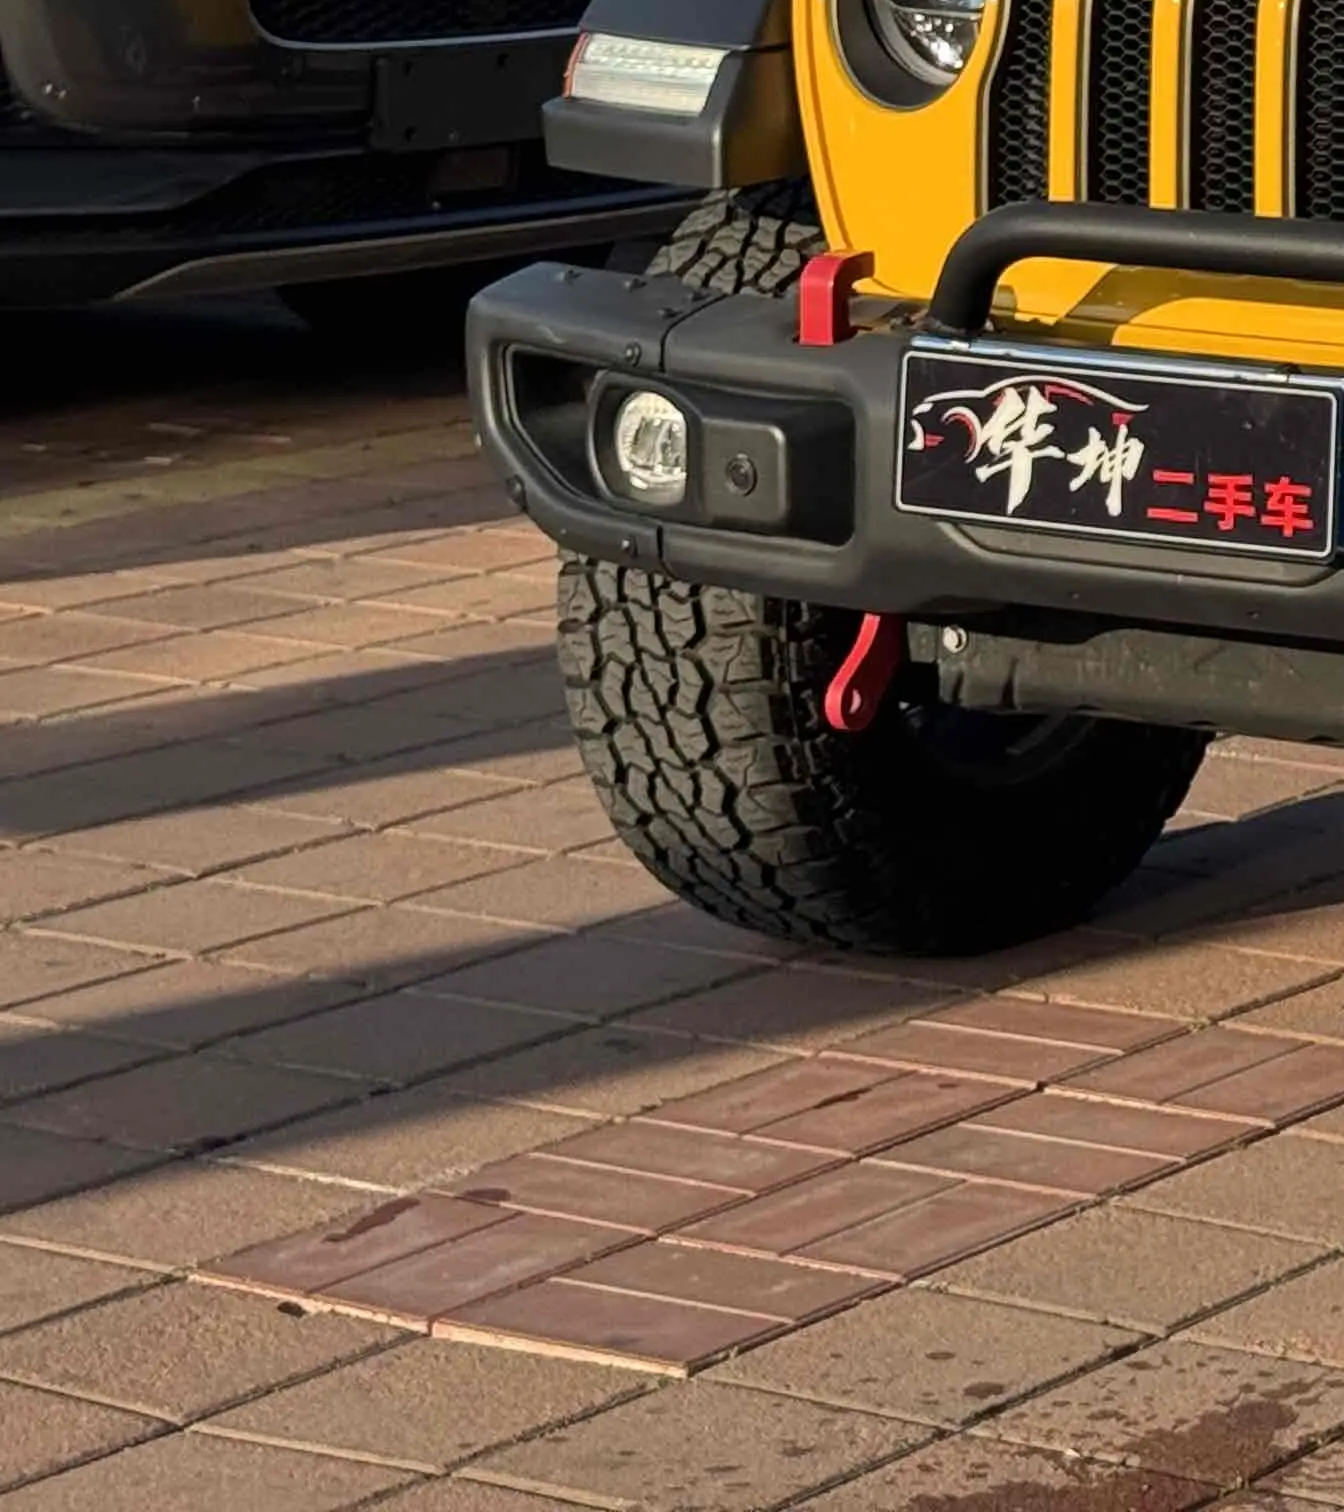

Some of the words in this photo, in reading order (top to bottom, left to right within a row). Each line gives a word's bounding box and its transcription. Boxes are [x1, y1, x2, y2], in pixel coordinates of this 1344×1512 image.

[974, 384, 1146, 516] 华坤
[1146, 468, 1314, 538] 二手车
